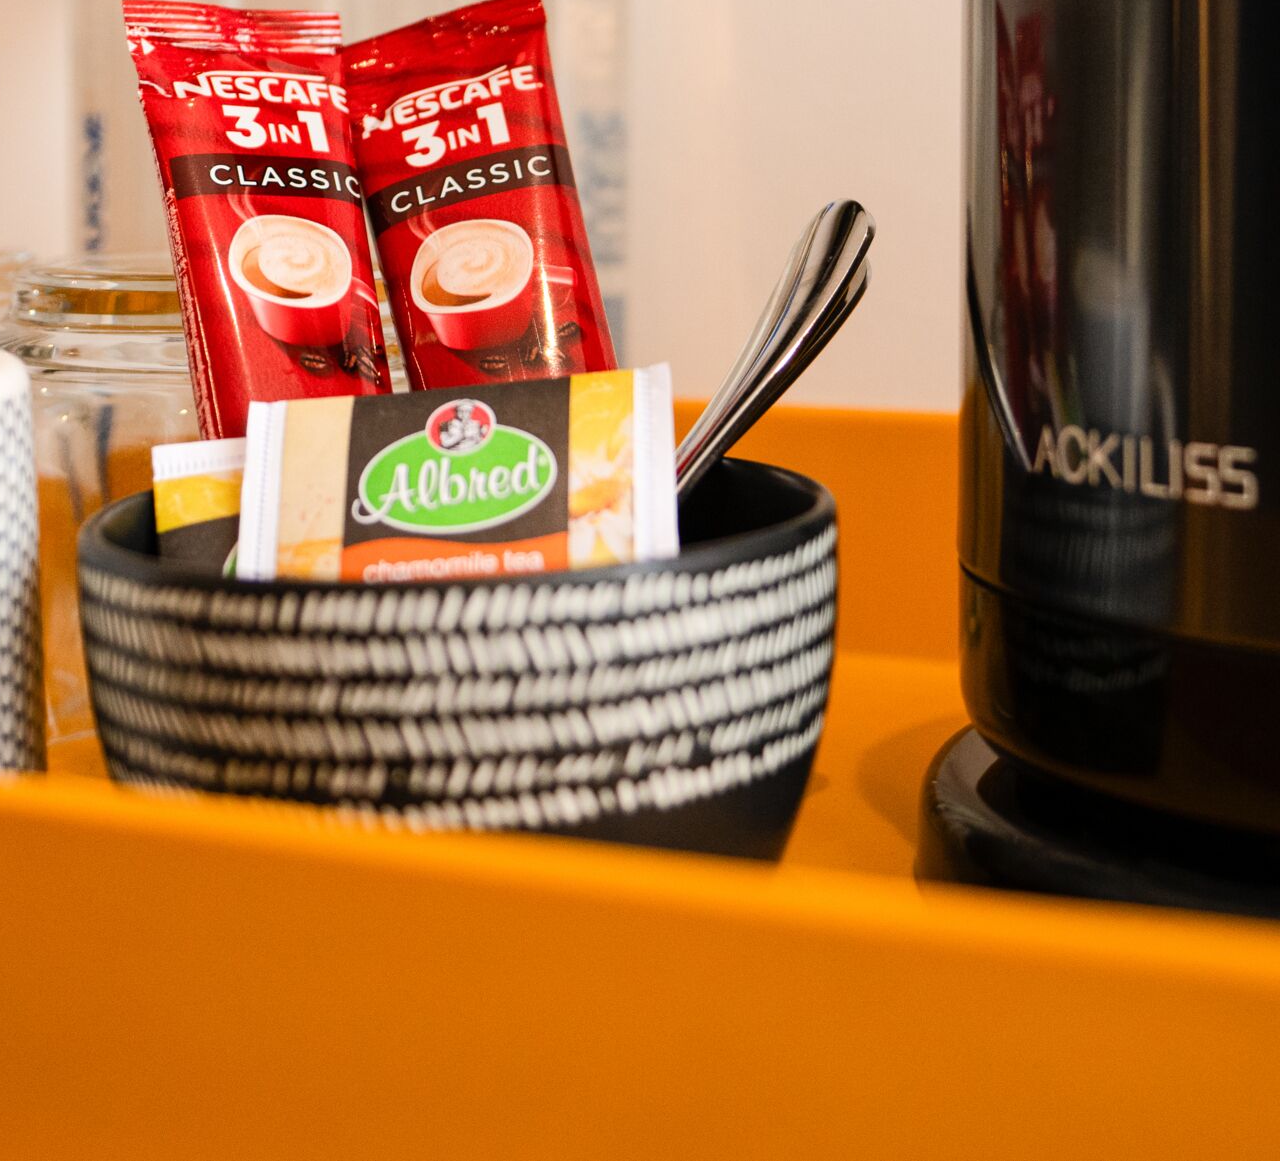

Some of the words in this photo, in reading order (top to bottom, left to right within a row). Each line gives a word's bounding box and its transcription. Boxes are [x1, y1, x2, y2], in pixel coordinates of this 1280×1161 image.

[210, 165, 361, 198] CLASSIC
[391, 156, 551, 212] CLASSIC
[352, 443, 540, 525] Albred
[363, 551, 499, 584] chamomile
[503, 549, 545, 572] tea
